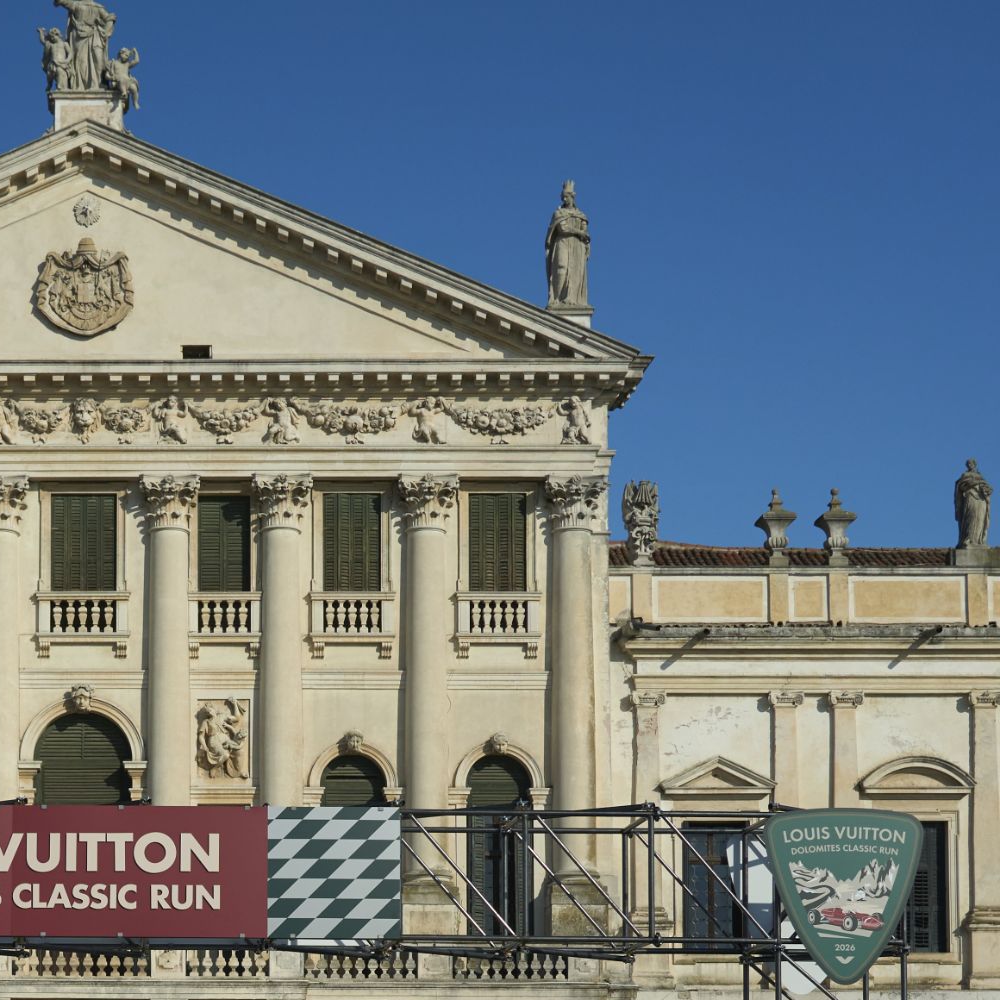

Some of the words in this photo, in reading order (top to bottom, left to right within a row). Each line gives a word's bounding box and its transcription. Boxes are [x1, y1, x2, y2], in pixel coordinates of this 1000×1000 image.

[783, 828, 830, 843] LOUIS
[835, 827, 906, 844] VUITTON
[791, 844, 840, 855] DOLOMITES
[843, 844, 877, 853] CLASSIC
[879, 847, 899, 855] RUN
[12, 883, 137, 909] CLASSIC
[150, 884, 221, 909] RUN
